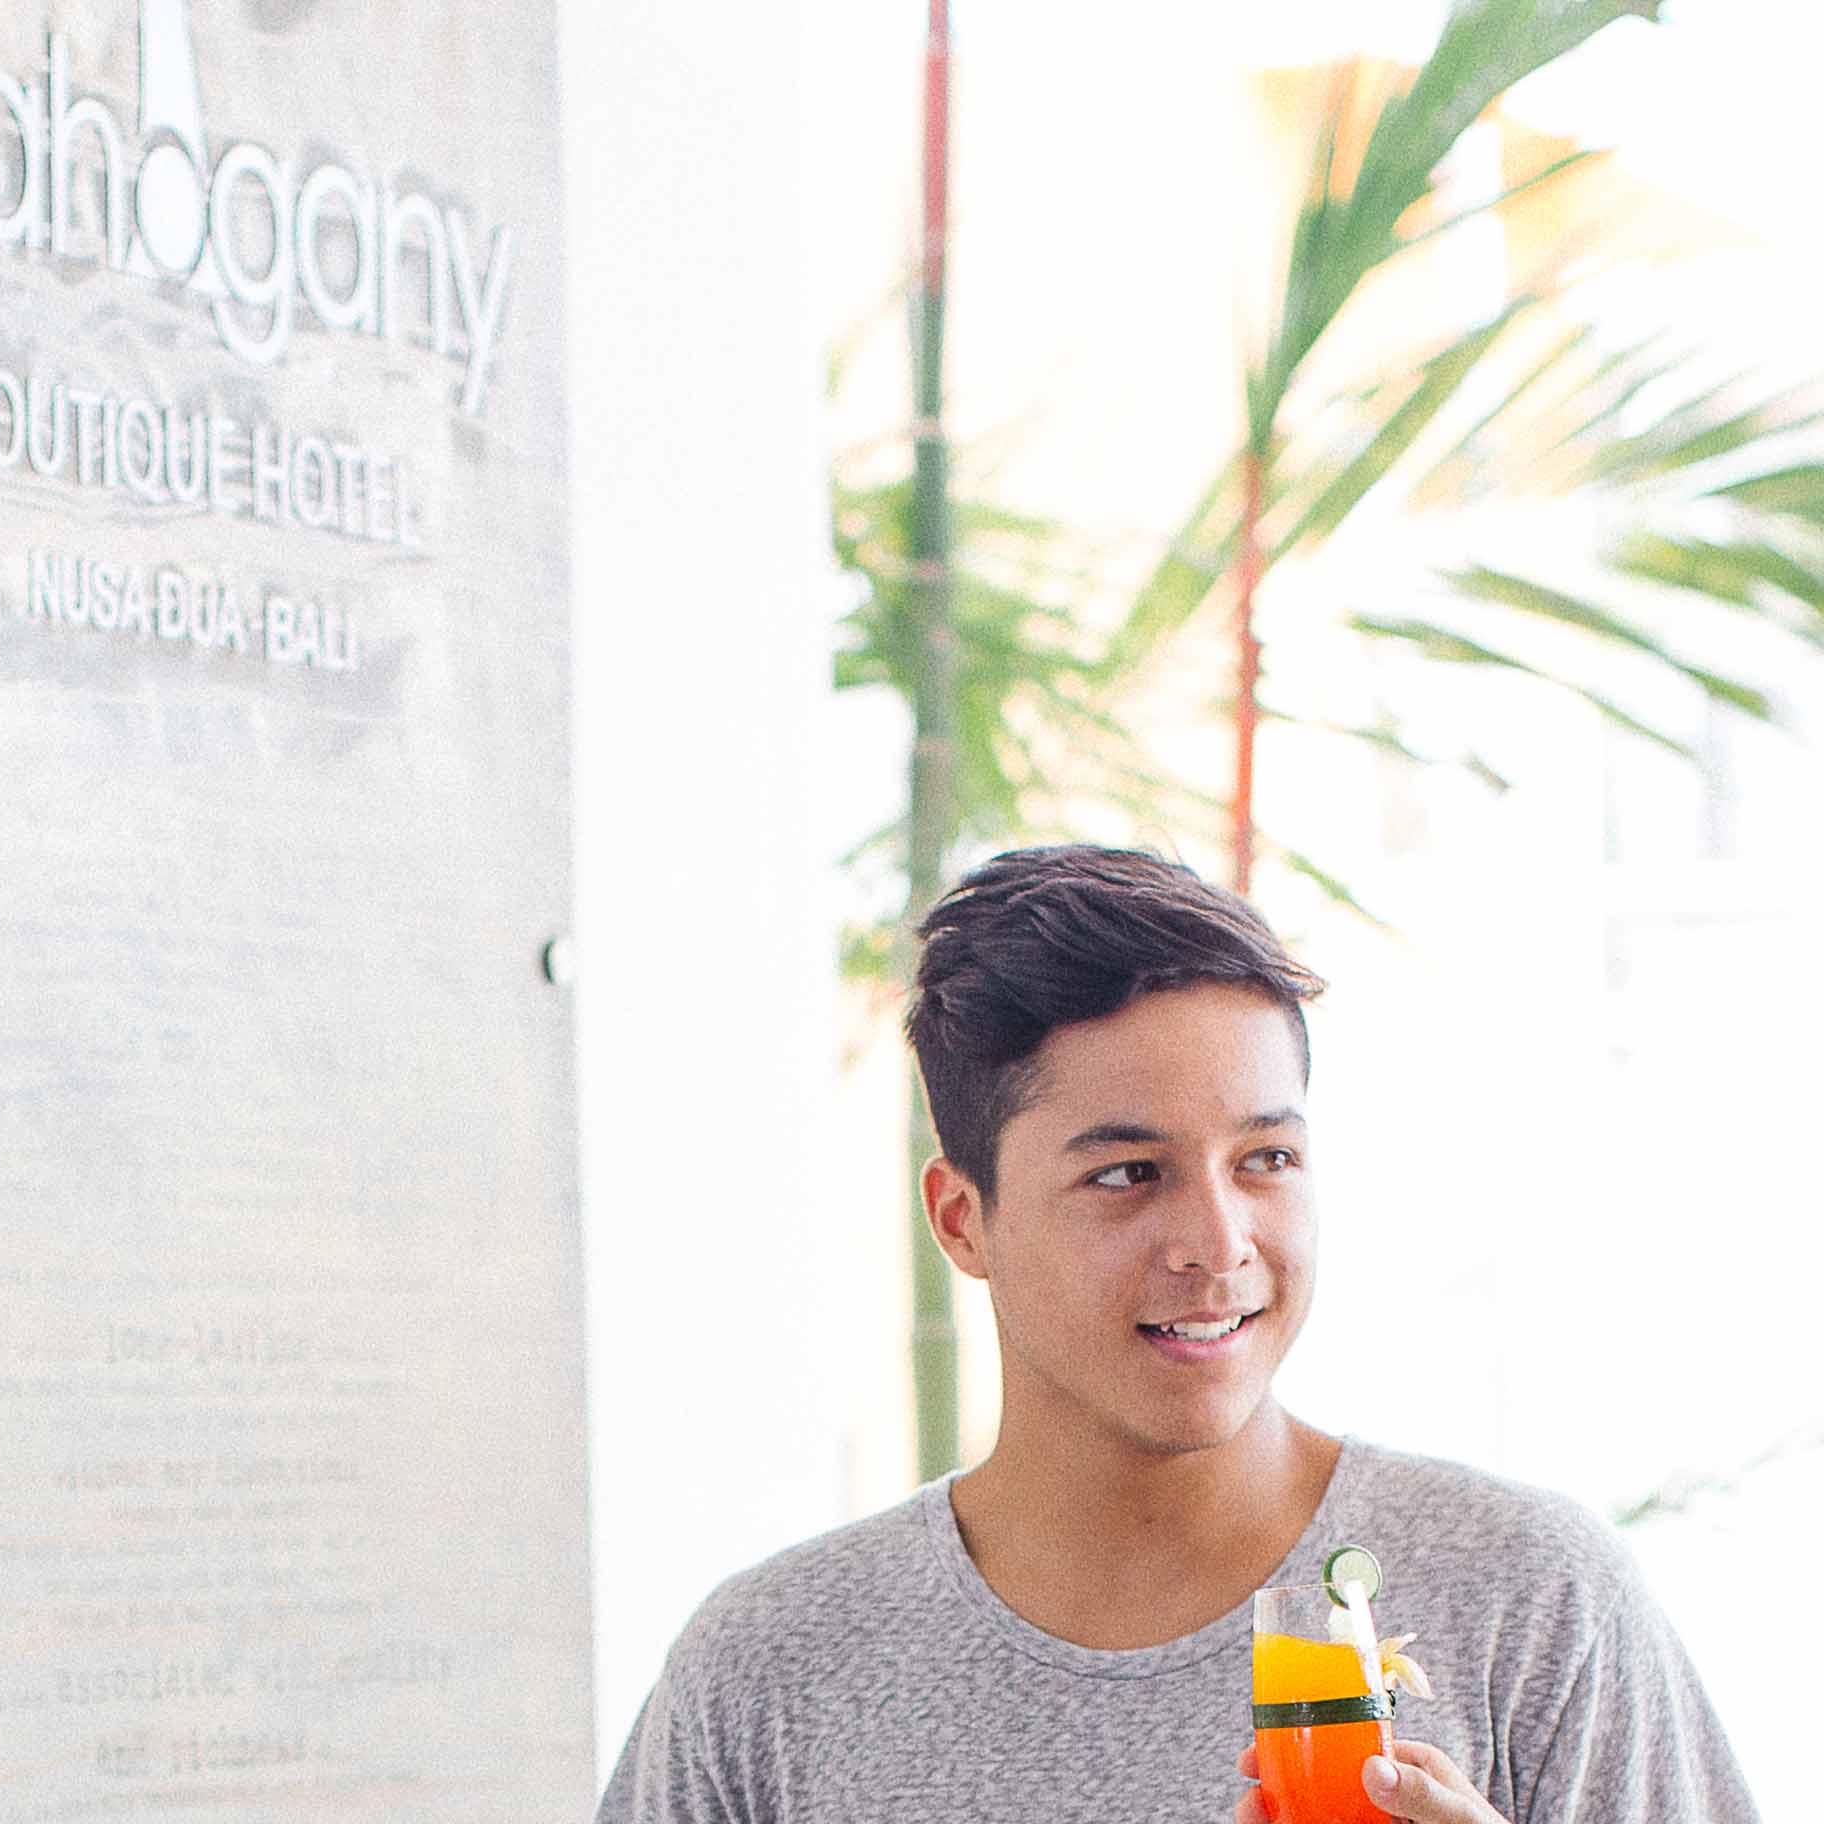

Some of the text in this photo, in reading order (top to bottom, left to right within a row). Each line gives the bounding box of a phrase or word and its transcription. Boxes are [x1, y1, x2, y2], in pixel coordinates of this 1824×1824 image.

[251, 426, 420, 546] HOTEL
[27, 548, 151, 635] NUSA
[156, 569, 249, 655] DUA
[264, 596, 361, 672] BALI
